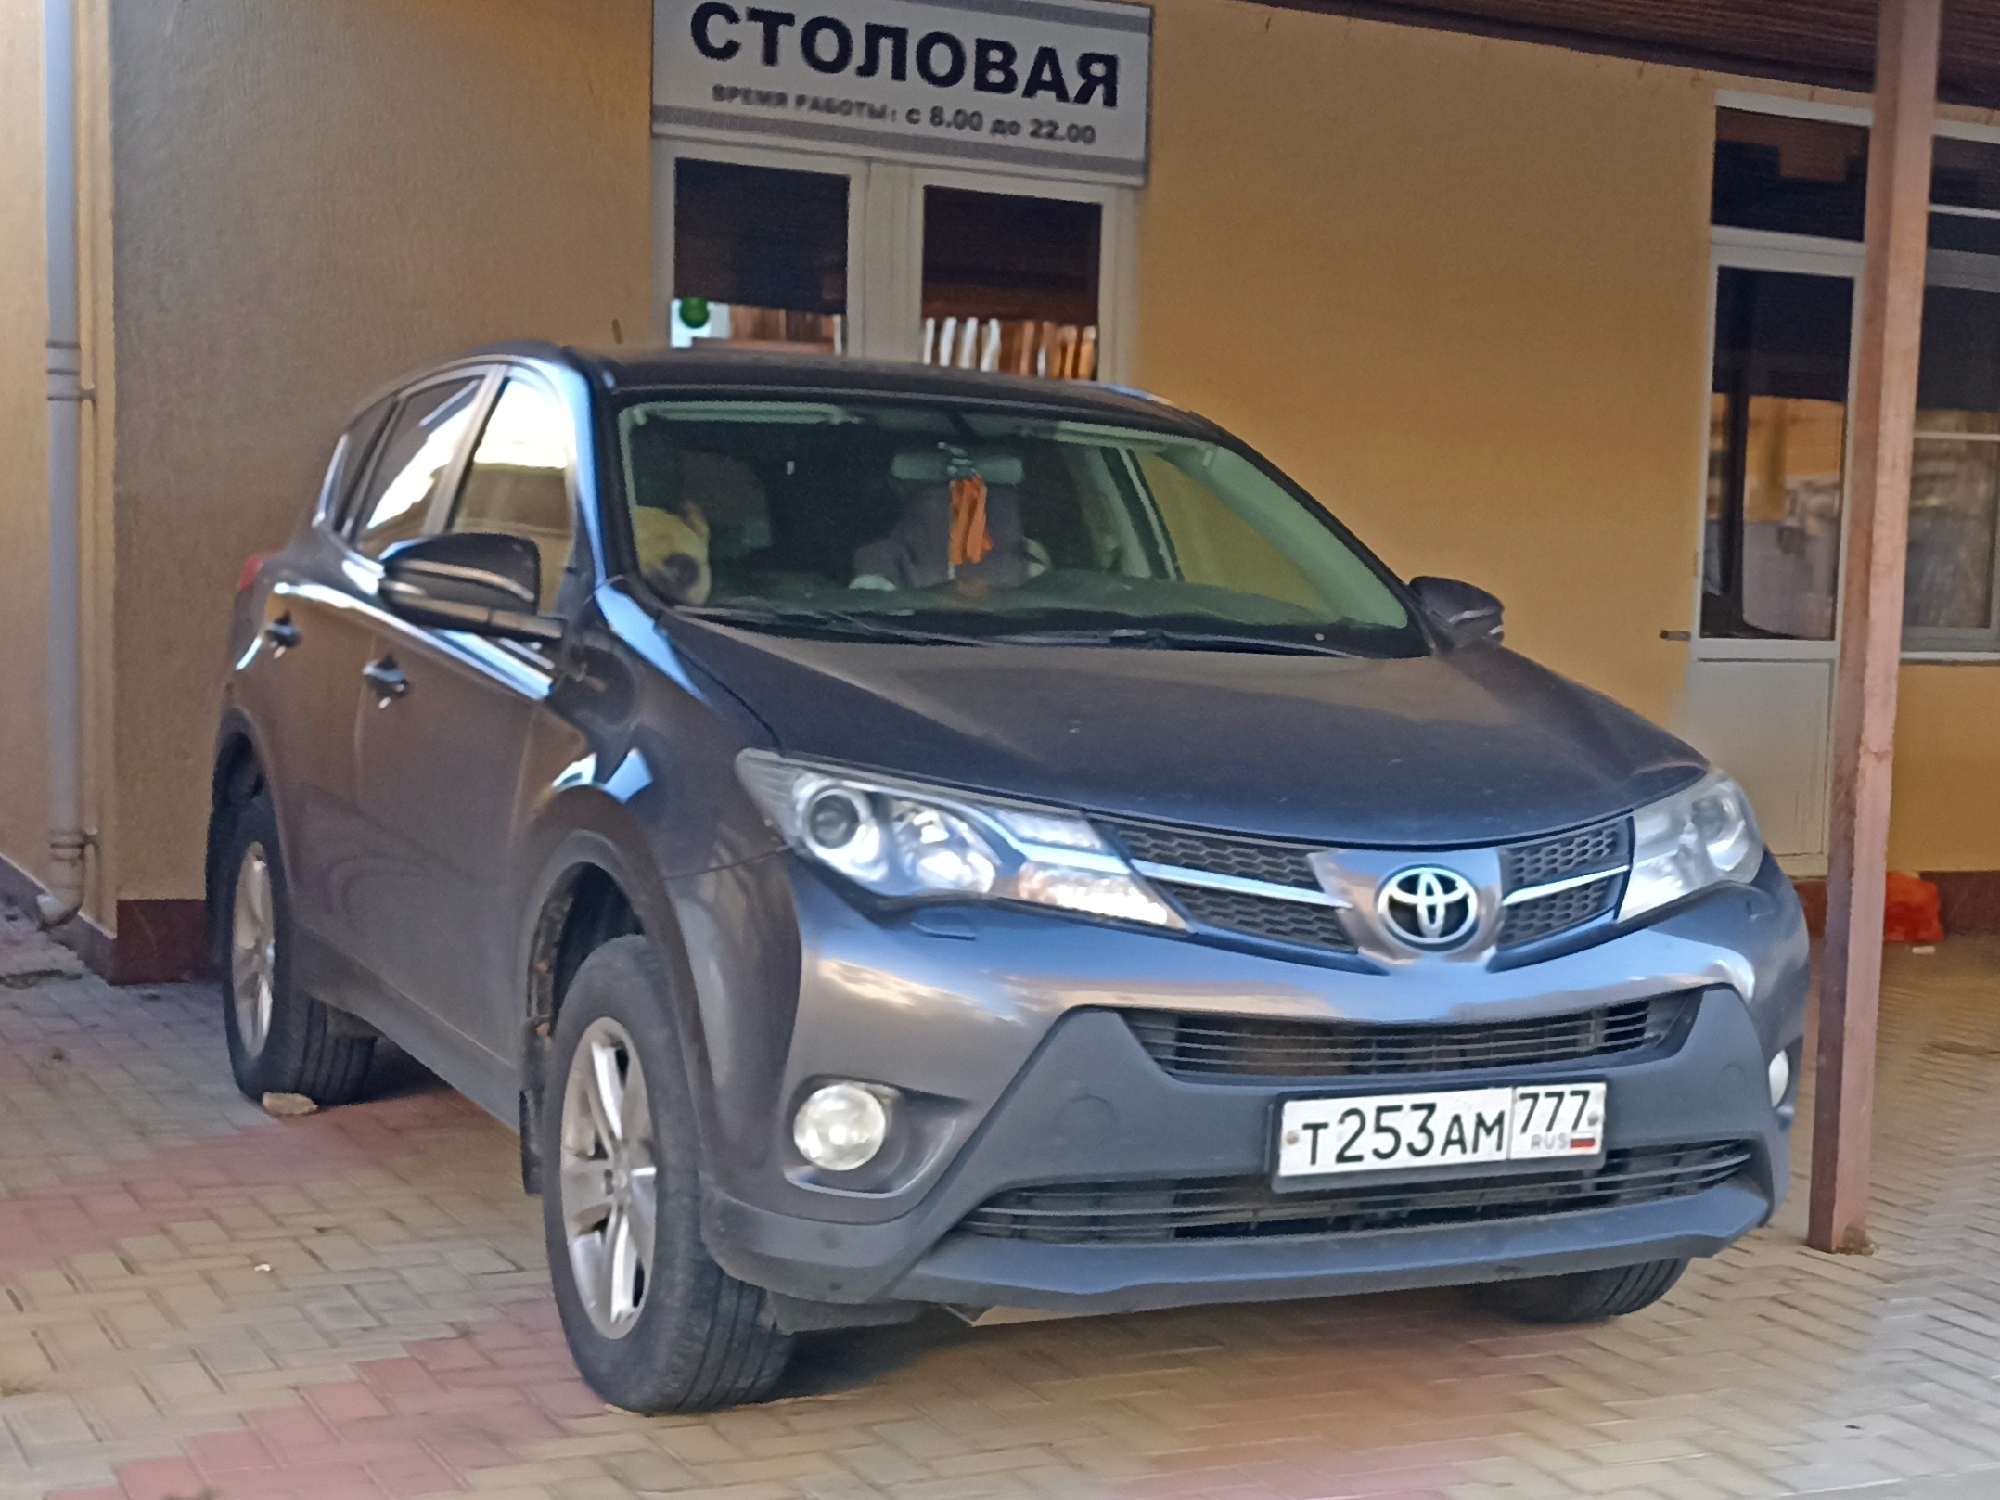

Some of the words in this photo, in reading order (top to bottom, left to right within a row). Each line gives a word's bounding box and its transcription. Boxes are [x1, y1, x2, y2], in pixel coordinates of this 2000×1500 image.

[690, 1, 1119, 108] СТОЛОВАЯ
[929, 105, 982, 132] 8.00
[1029, 117, 1096, 145] 22.00
[1302, 1102, 1506, 1166] Т253АМ
[1519, 1090, 1591, 1136] 777
[1531, 1132, 1570, 1151] RUS
